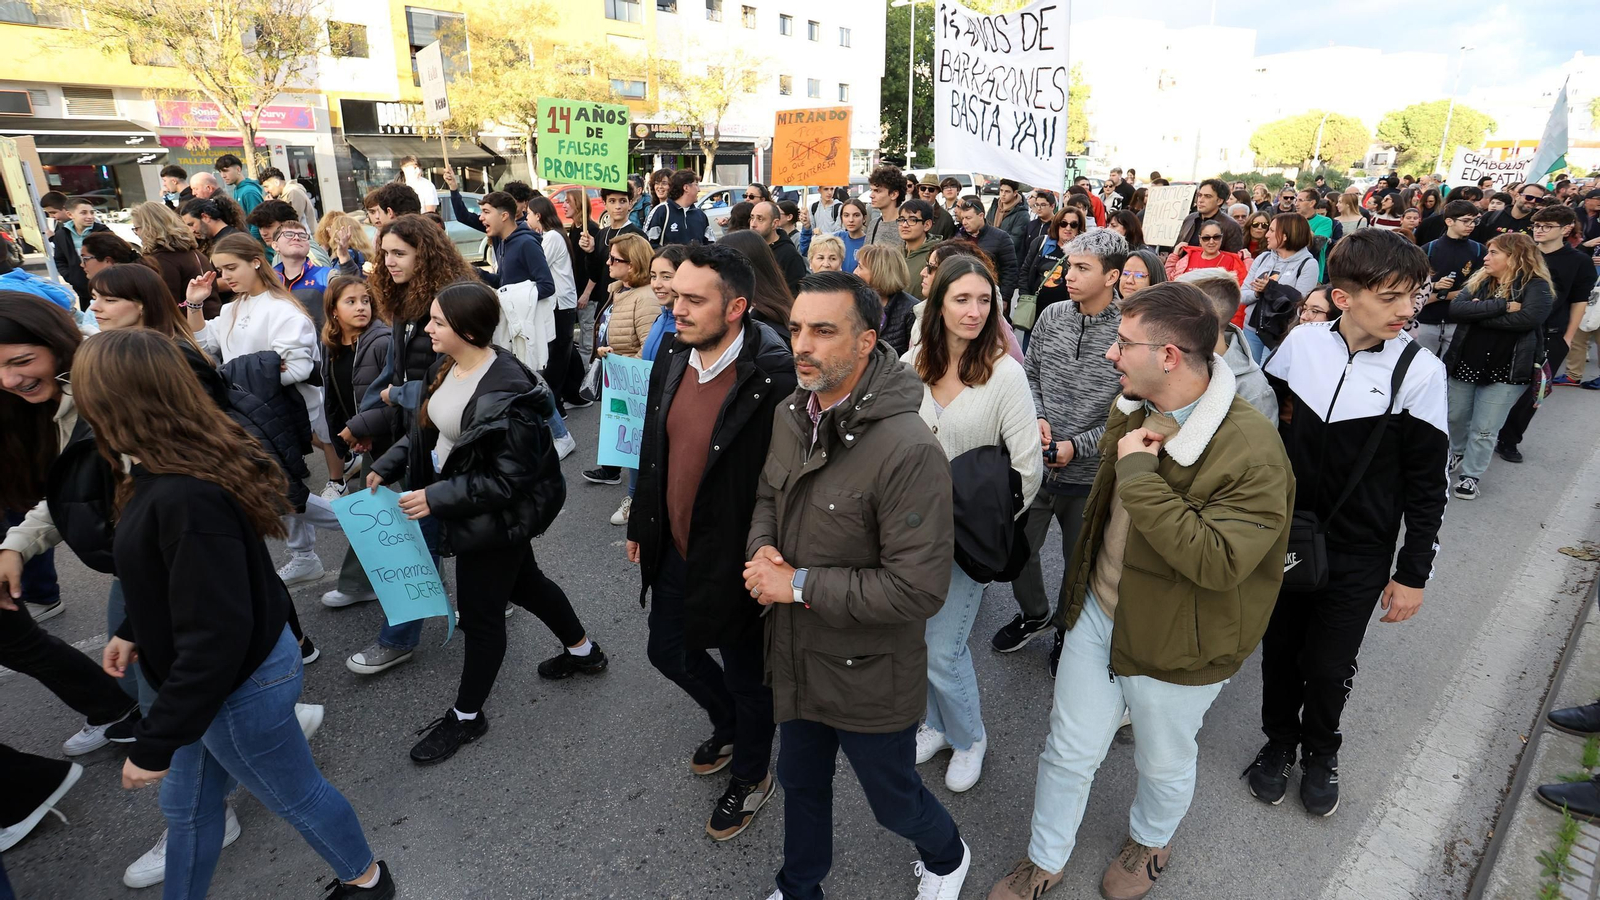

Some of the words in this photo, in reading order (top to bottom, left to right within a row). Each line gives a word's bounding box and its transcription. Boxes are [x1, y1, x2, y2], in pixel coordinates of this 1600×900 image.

[1020, 5, 1057, 52] DE
[547, 105, 571, 135] 14
[574, 104, 628, 126] AÑOS
[777, 110, 848, 126] MIRANDO
[950, 89, 1001, 147] BASTA
[1010, 110, 1057, 161] YA!!
[586, 126, 603, 139] DE
[557, 139, 609, 157] FALSAS
[178, 157, 213, 165] TALLAS
[543, 156, 620, 183] PROMESAS
[797, 159, 836, 182] INTERESA
[371, 563, 433, 583] Tenemos
